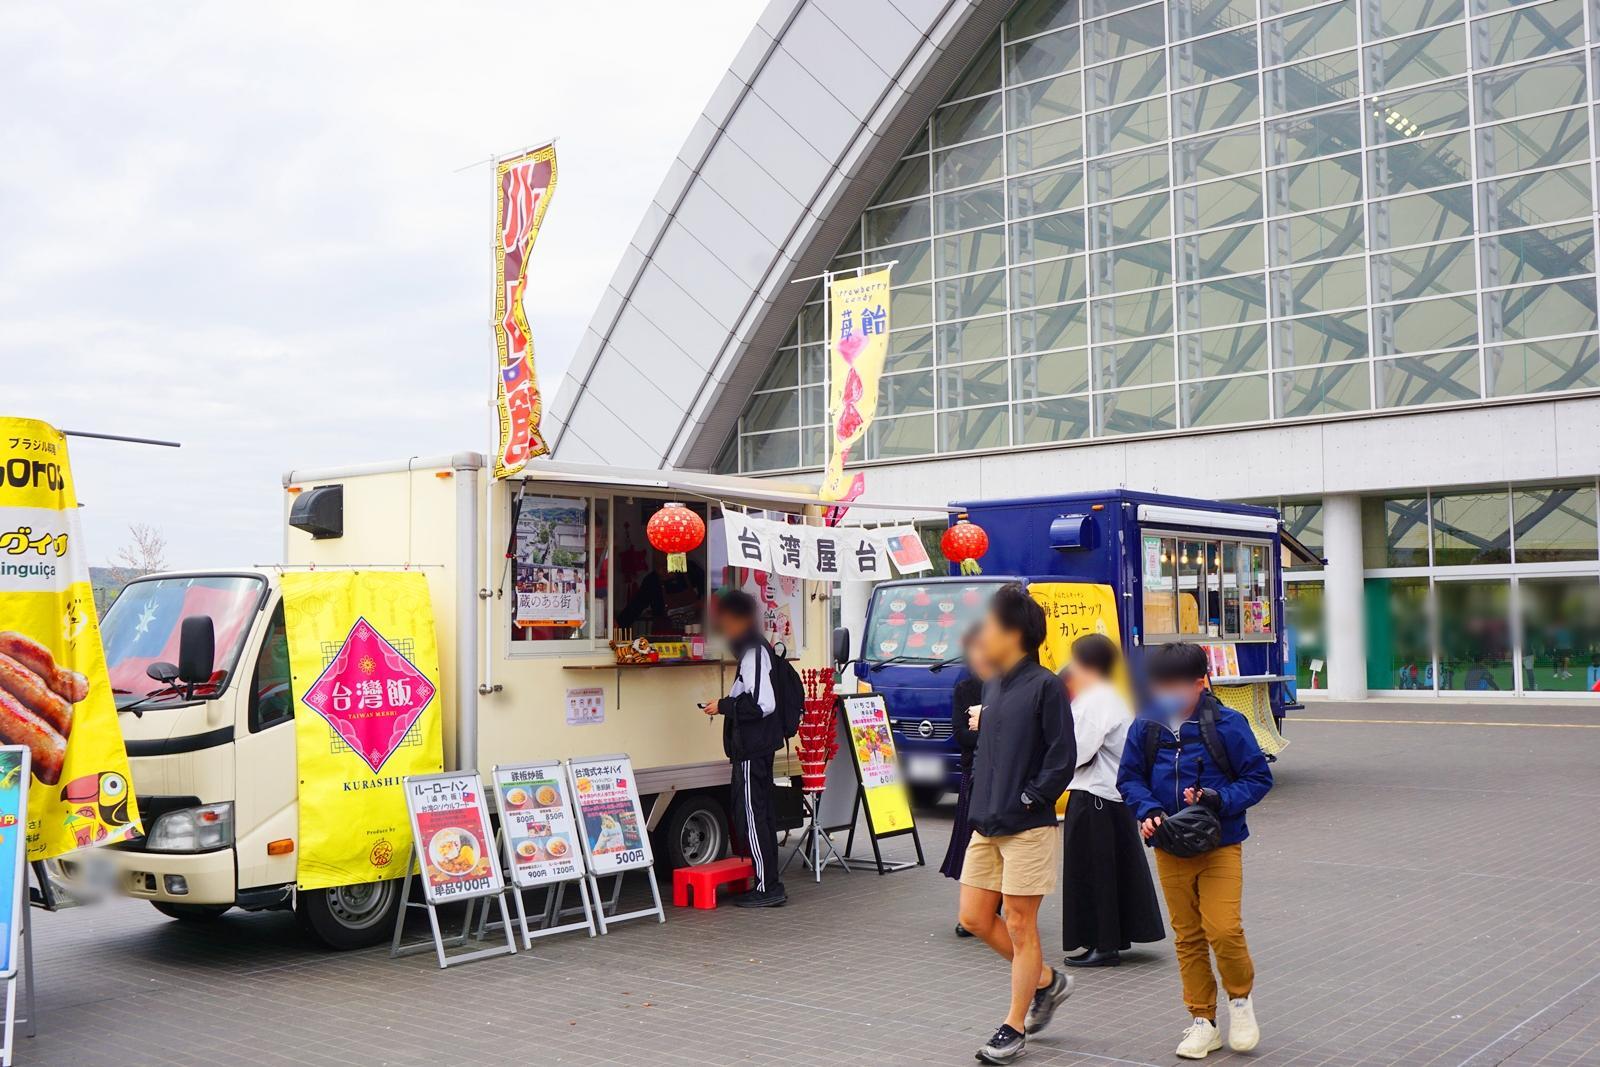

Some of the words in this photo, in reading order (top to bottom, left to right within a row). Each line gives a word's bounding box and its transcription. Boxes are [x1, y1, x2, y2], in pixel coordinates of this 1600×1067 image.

[738, 526, 877, 573] 台湾屋台
[519, 594, 571, 609] 蔵のある街
[1059, 622, 1089, 637] カレー
[511, 770, 545, 781] 鉄板炒飯
[415, 781, 468, 796] ルーローハン
[0, 814, 15, 826] 円
[516, 815, 535, 824] 800円
[615, 850, 645, 865] 500円
[527, 867, 547, 878] 900円
[552, 865, 575, 876] 1200円
[434, 877, 491, 897] 単品900円
